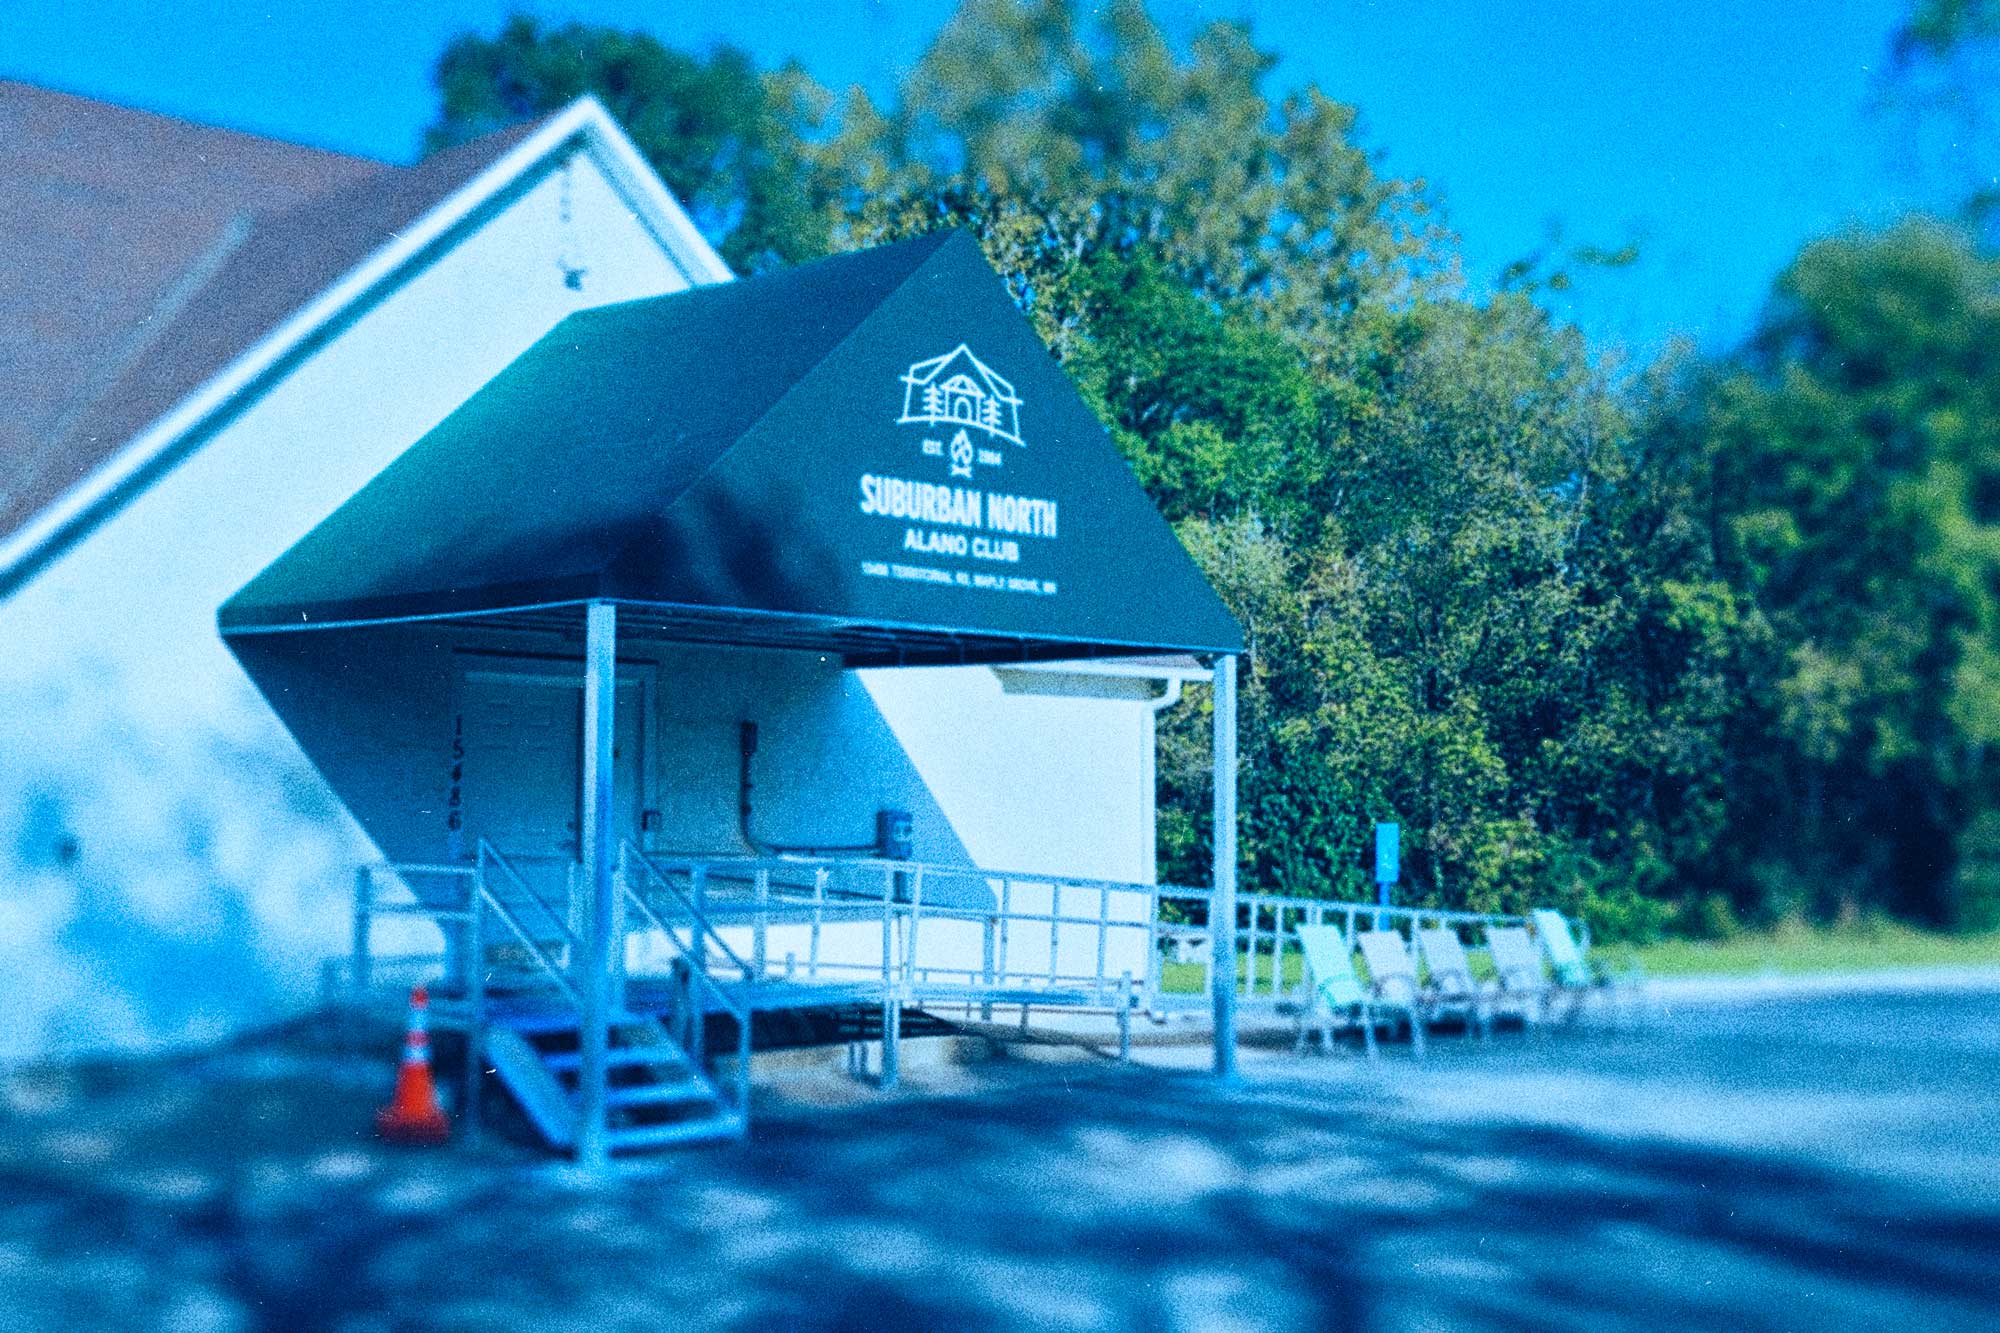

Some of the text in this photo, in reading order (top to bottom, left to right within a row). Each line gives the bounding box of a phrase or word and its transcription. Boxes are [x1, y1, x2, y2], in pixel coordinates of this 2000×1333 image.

[860, 473, 1057, 538] SUBURBAN NORTH
[904, 528, 1019, 562] ALANO CLUB
